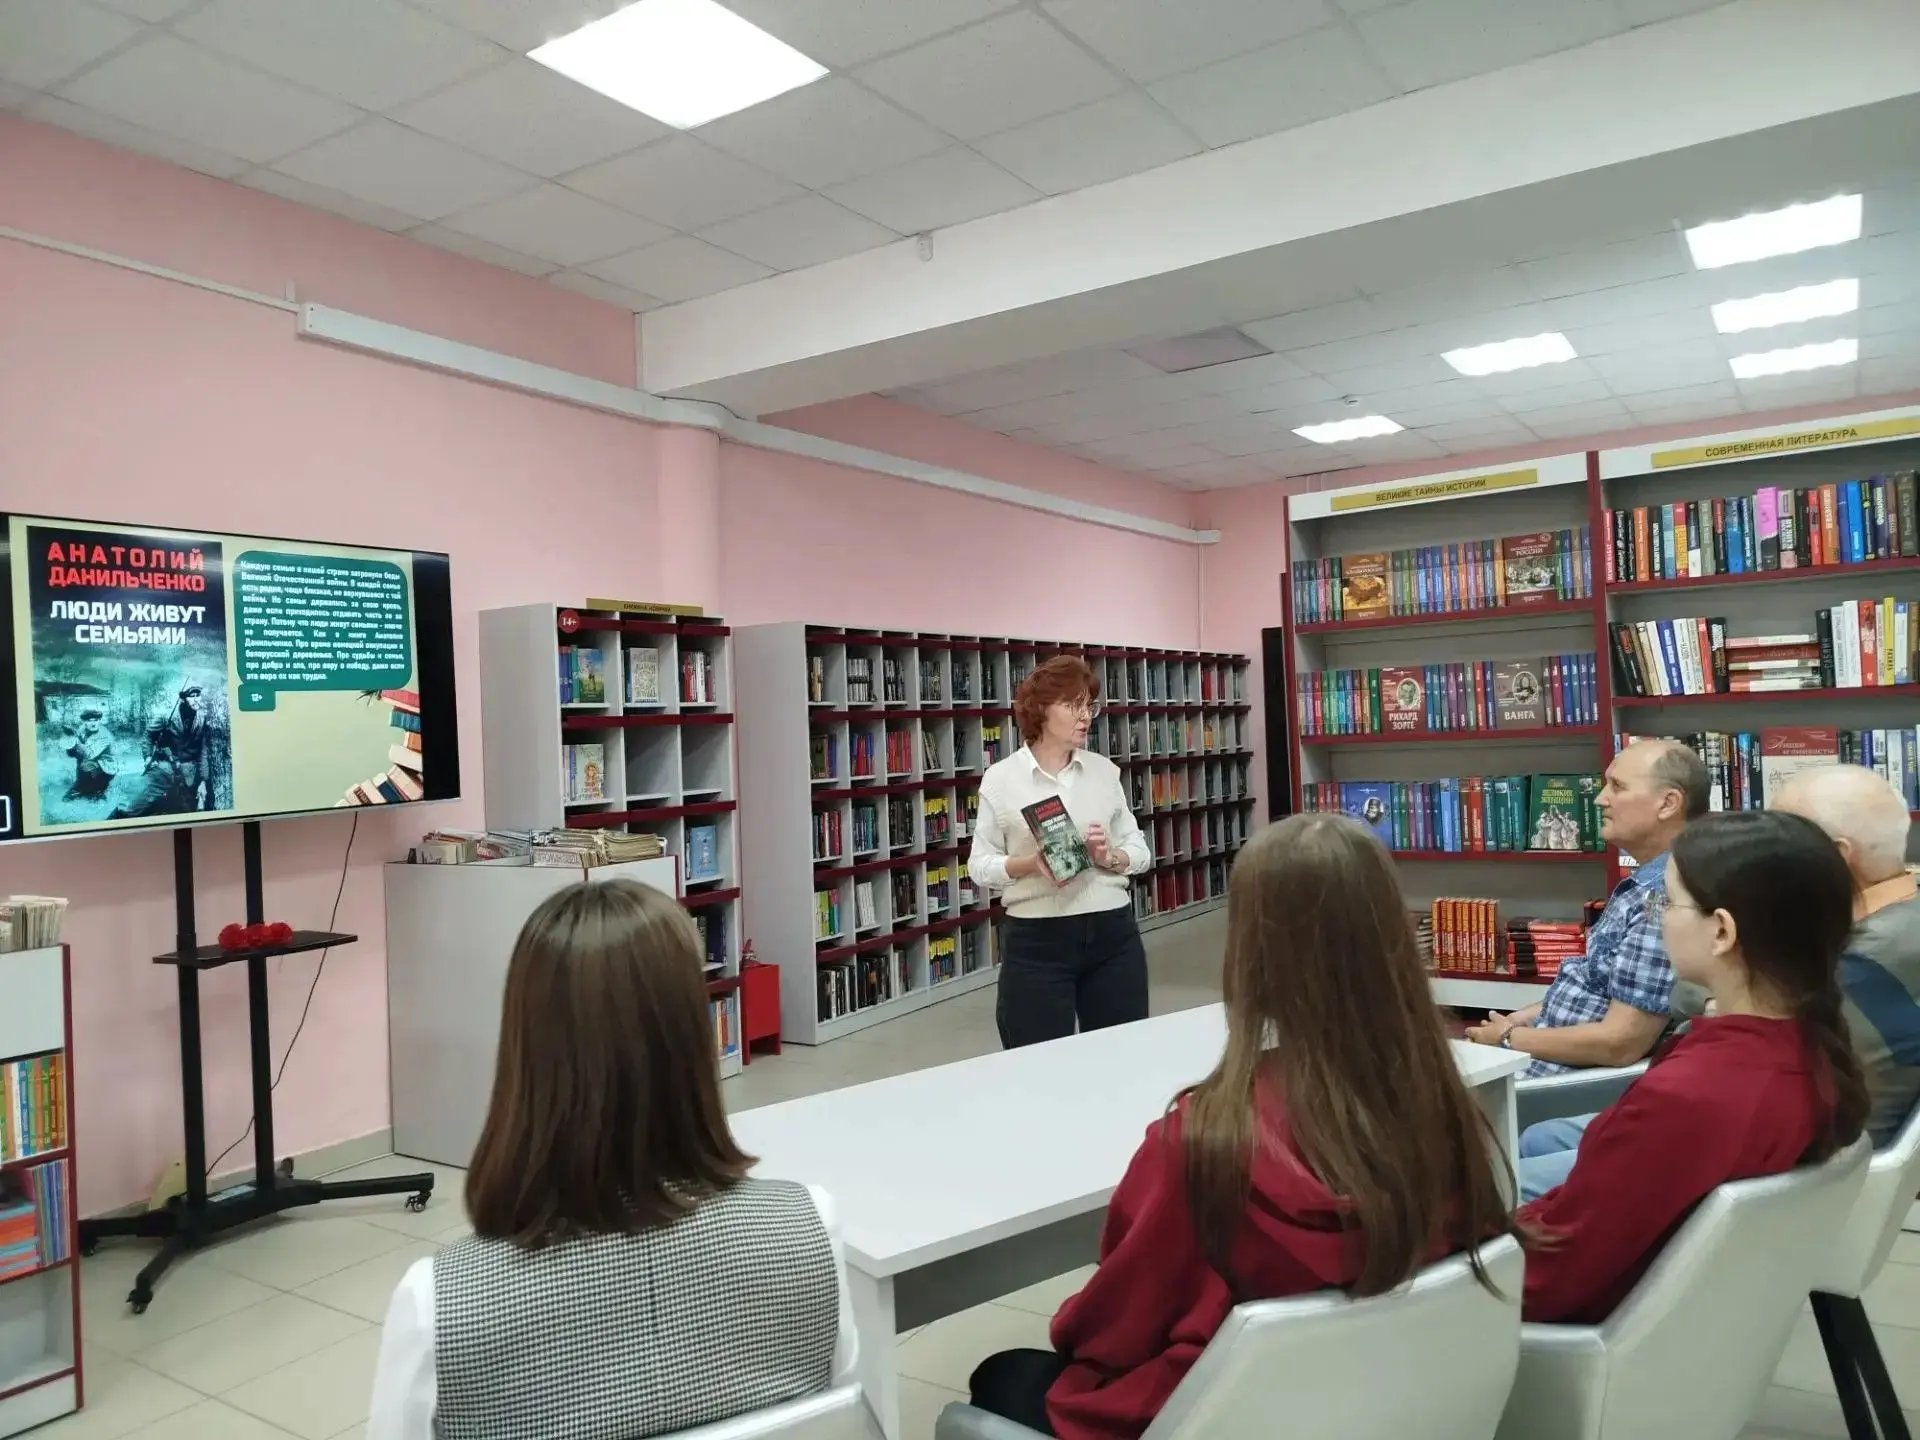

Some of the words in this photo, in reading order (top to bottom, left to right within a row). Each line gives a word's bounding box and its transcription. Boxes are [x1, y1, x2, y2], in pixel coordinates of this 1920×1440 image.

[1705, 438, 1784, 457] СОВРЕМЕННАЯ
[1787, 428, 1858, 446] ЛИТЕРАТУРА
[1376, 489, 1412, 501] ВЕЛИКИЕ
[1446, 479, 1486, 491] ИСТОРИИ
[48, 542, 204, 570] АНАТОЛИЙ
[48, 566, 205, 592] ДАНИЛЬЧЕНКО
[50, 600, 122, 622] ЛЮДИ
[129, 604, 206, 623] ЖИВУТ
[563, 616, 577, 626] 14+
[75, 624, 186, 645] СЕМЬЯМИ
[1388, 712, 1418, 721] РИХАРД
[1392, 721, 1416, 730] ЗОРГЕ
[1504, 710, 1535, 720] ВАНГА
